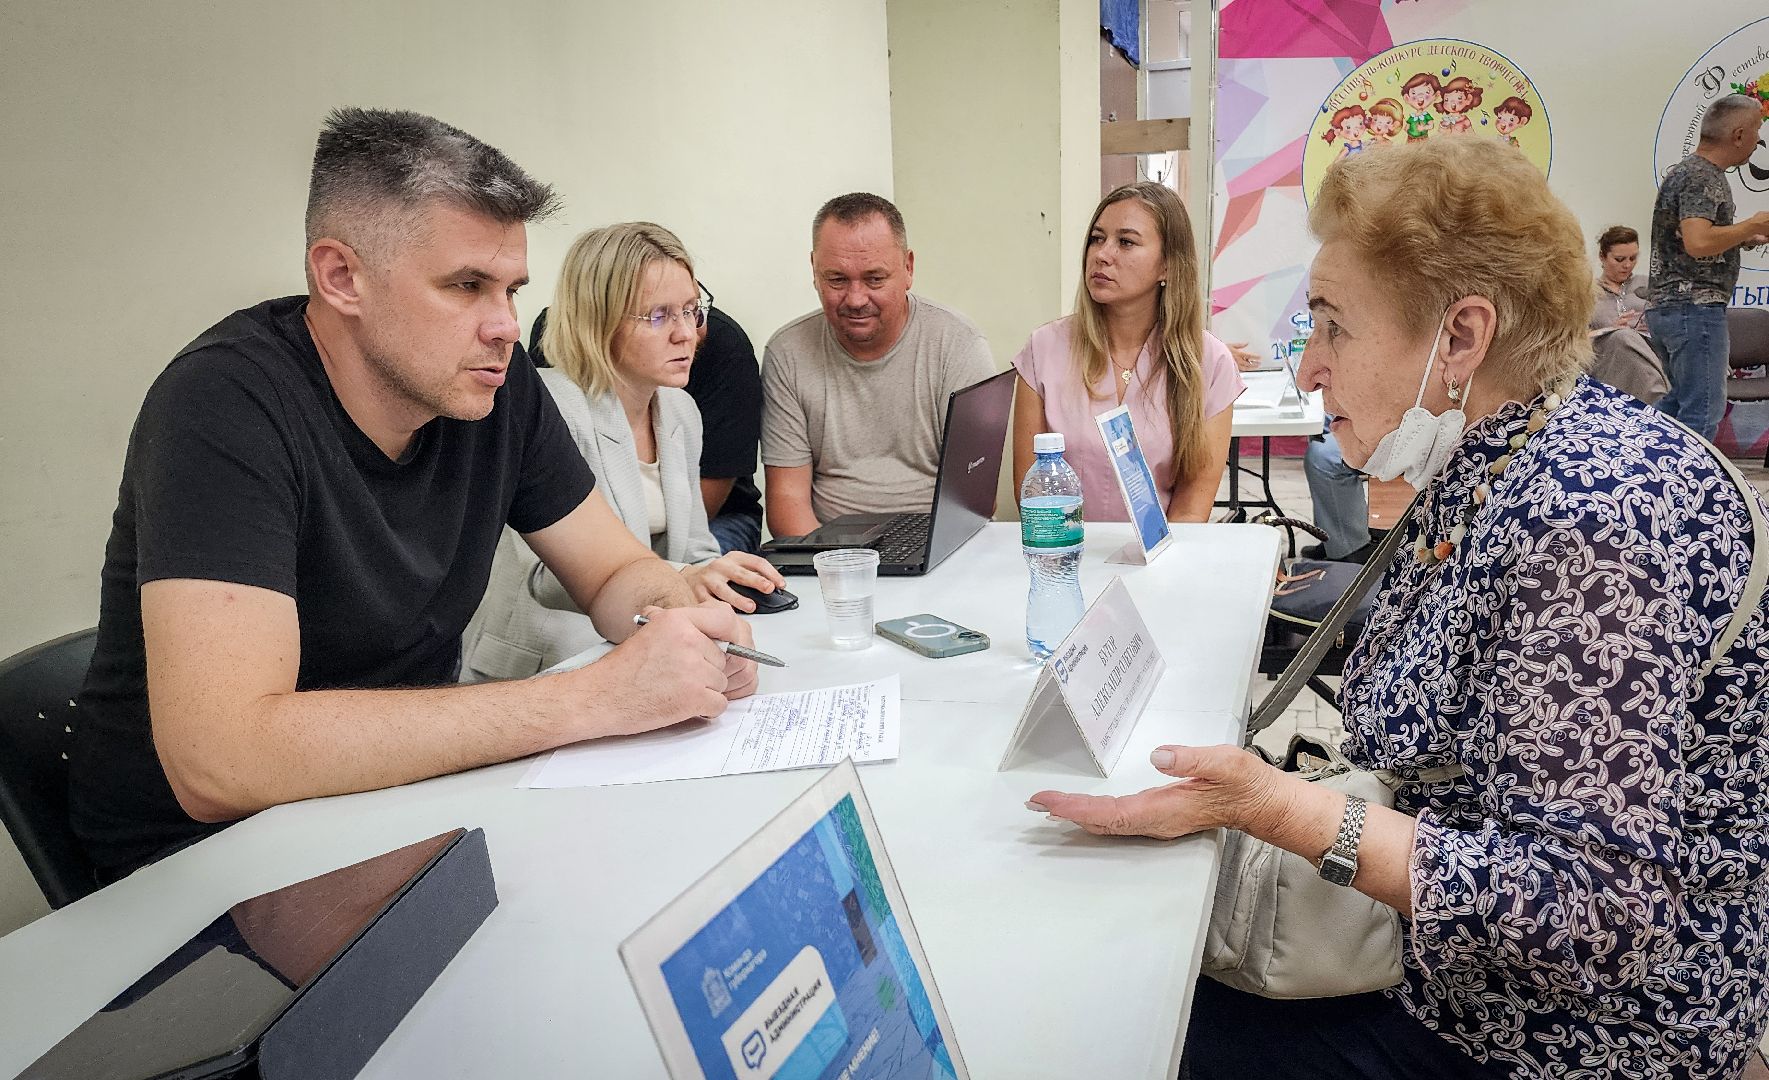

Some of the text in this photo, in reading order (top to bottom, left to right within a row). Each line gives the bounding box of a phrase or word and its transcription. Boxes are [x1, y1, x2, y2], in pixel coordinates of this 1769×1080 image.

[1427, 45, 1477, 60] ДЕТСКОГО
[764, 987, 799, 1030] ВЫЕЗДНАЯ
[770, 978, 822, 1043] АДМИНИСТРАЦИЯ
